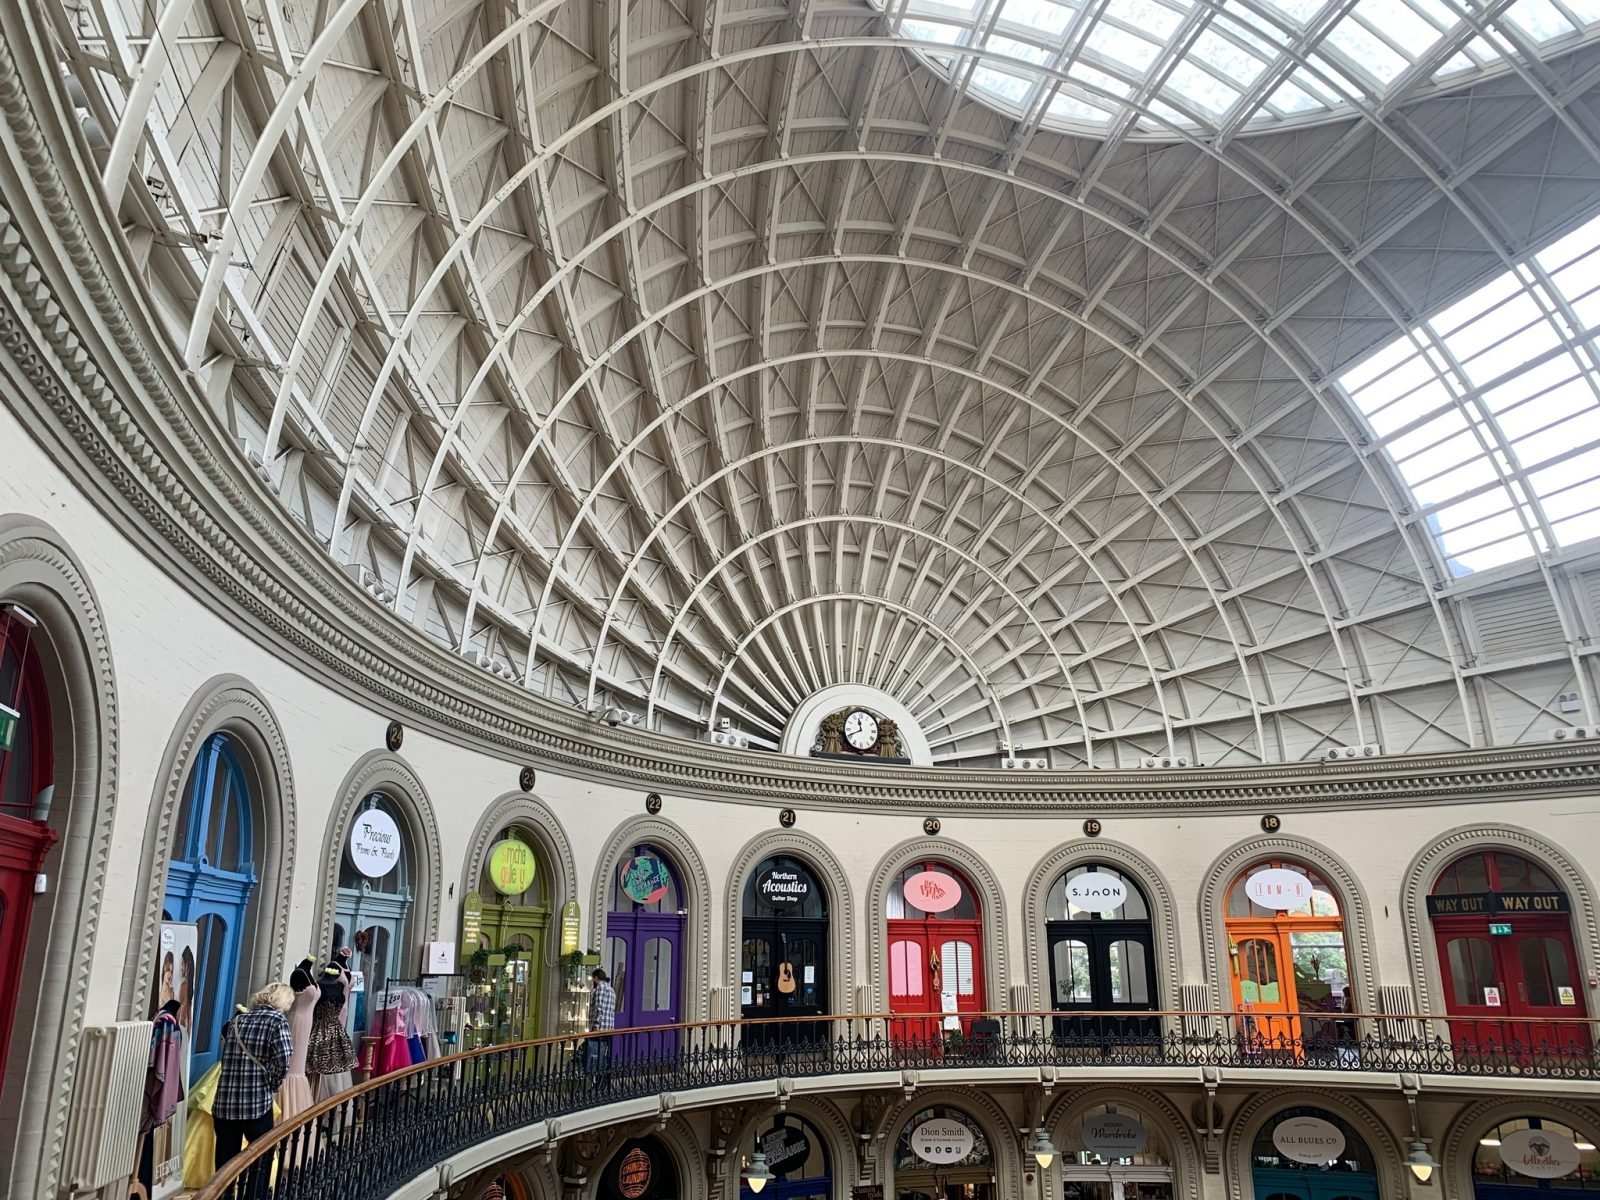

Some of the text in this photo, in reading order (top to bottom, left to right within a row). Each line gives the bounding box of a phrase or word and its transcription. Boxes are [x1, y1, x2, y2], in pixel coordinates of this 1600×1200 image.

[391, 727, 402, 744] 24
[524, 772, 534, 786] 23
[650, 797, 661, 809] 22
[783, 812, 793, 823] 21
[1265, 817, 1278, 828] 18
[926, 820, 940, 830] 20
[1087, 822, 1100, 832] 19
[362, 821, 392, 844] Precious
[371, 846, 378, 857] &
[772, 871, 797, 880] Northern
[762, 879, 807, 894] Acoustics
[1435, 898, 1484, 912] WAY OUT
[1502, 896, 1559, 910] WAY OUT
[920, 1127, 965, 1136] Dion Smith
[1091, 1127, 1137, 1139] Wardrobe
[1298, 1137, 1325, 1145] BLUES
